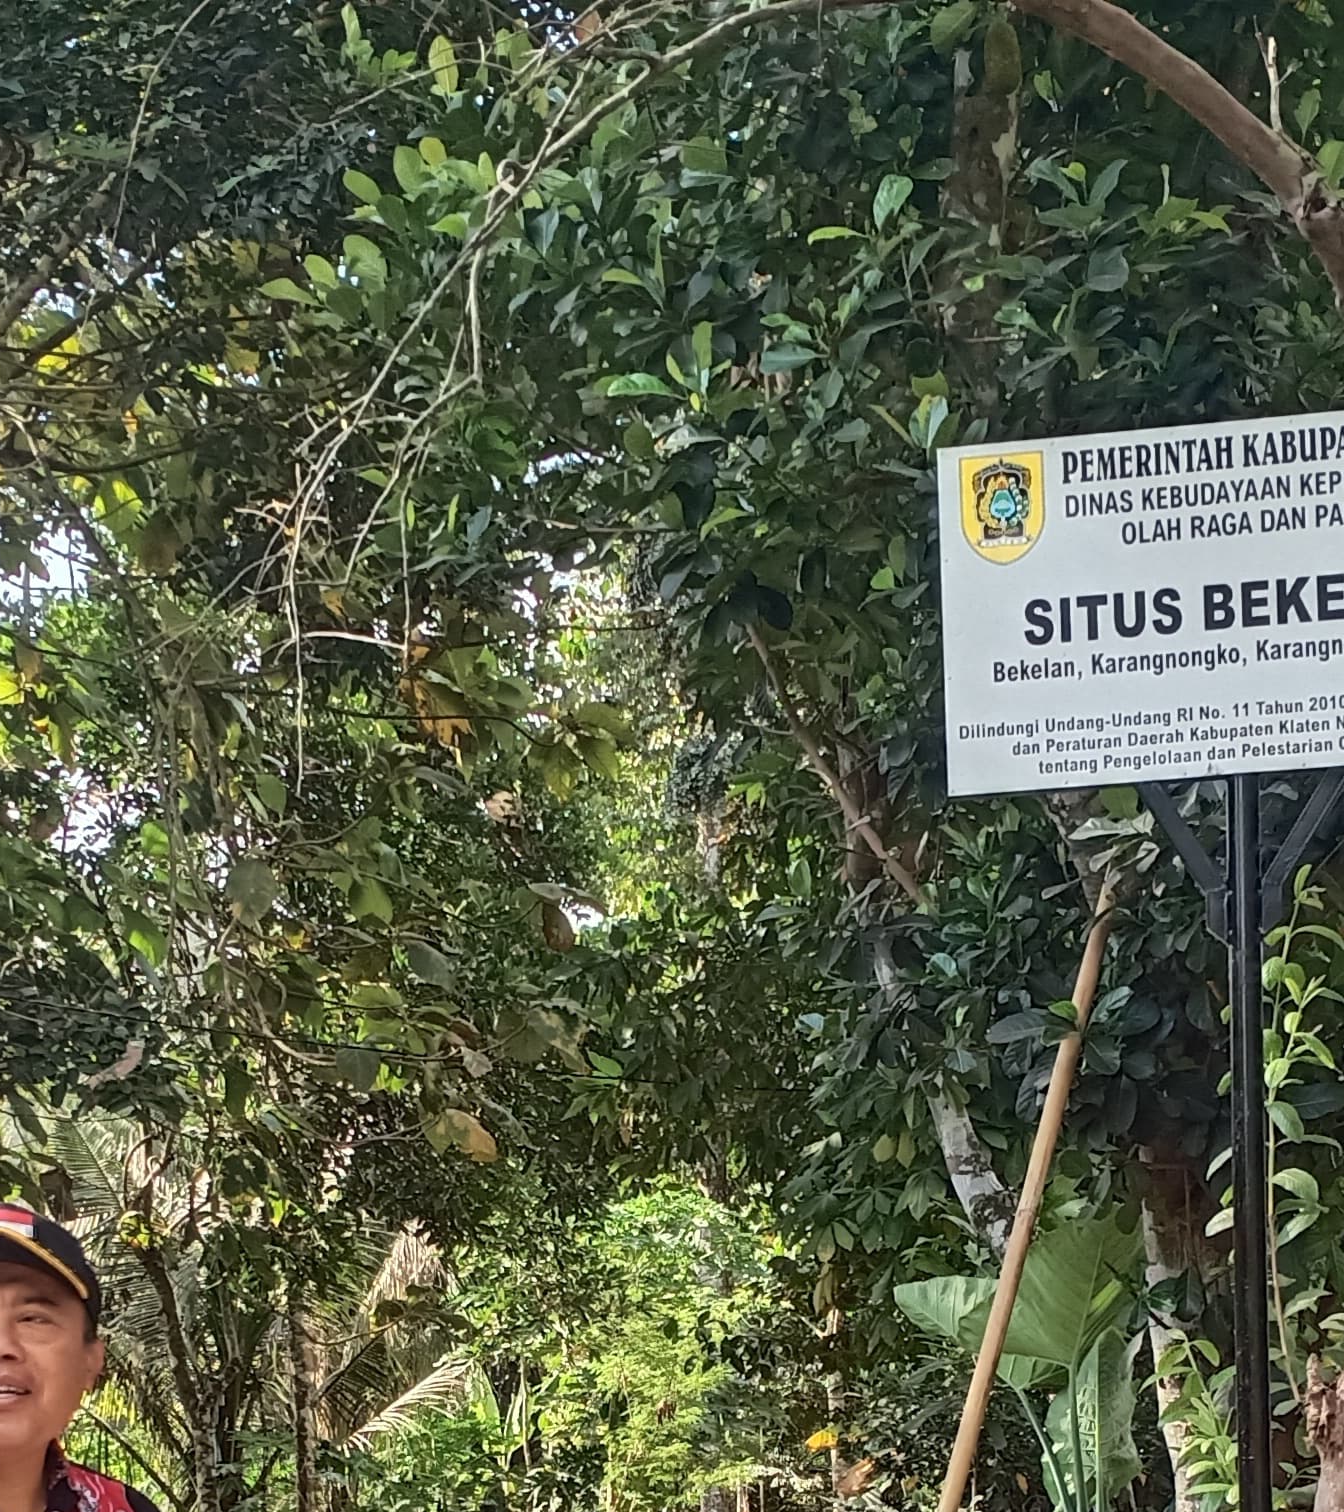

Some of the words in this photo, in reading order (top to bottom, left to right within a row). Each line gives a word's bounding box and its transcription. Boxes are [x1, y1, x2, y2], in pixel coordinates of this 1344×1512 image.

[1061, 435, 1235, 485] PEMERINTAH
[1065, 489, 1134, 518] DINAS
[1141, 474, 1291, 512] KEBUDAYAAN
[1121, 517, 1182, 546] OLAH
[1190, 511, 1253, 540] RAGA
[1260, 505, 1306, 533] DAN
[1023, 587, 1183, 646] SITUS
[993, 657, 1083, 683] Bekelan,
[1091, 642, 1247, 676] Karangnongko,
[959, 719, 1039, 740] Dilindungi
[1045, 711, 1171, 733] Undang-Undang
[1177, 706, 1194, 723] RI
[1199, 705, 1225, 721] No.
[1232, 702, 1249, 718] 11
[1255, 700, 1304, 716] Tahun
[1012, 741, 1041, 756] dan
[1046, 736, 1122, 753] Peraturan
[1127, 728, 1184, 747] Daerah
[1190, 723, 1274, 742] Kabupaten
[1279, 719, 1330, 735] Klaten
[1038, 758, 1098, 774] tentang
[1103, 749, 1202, 769] Pengelolaan
[1207, 745, 1236, 760] dan
[1241, 738, 1333, 758] Pelestarian
